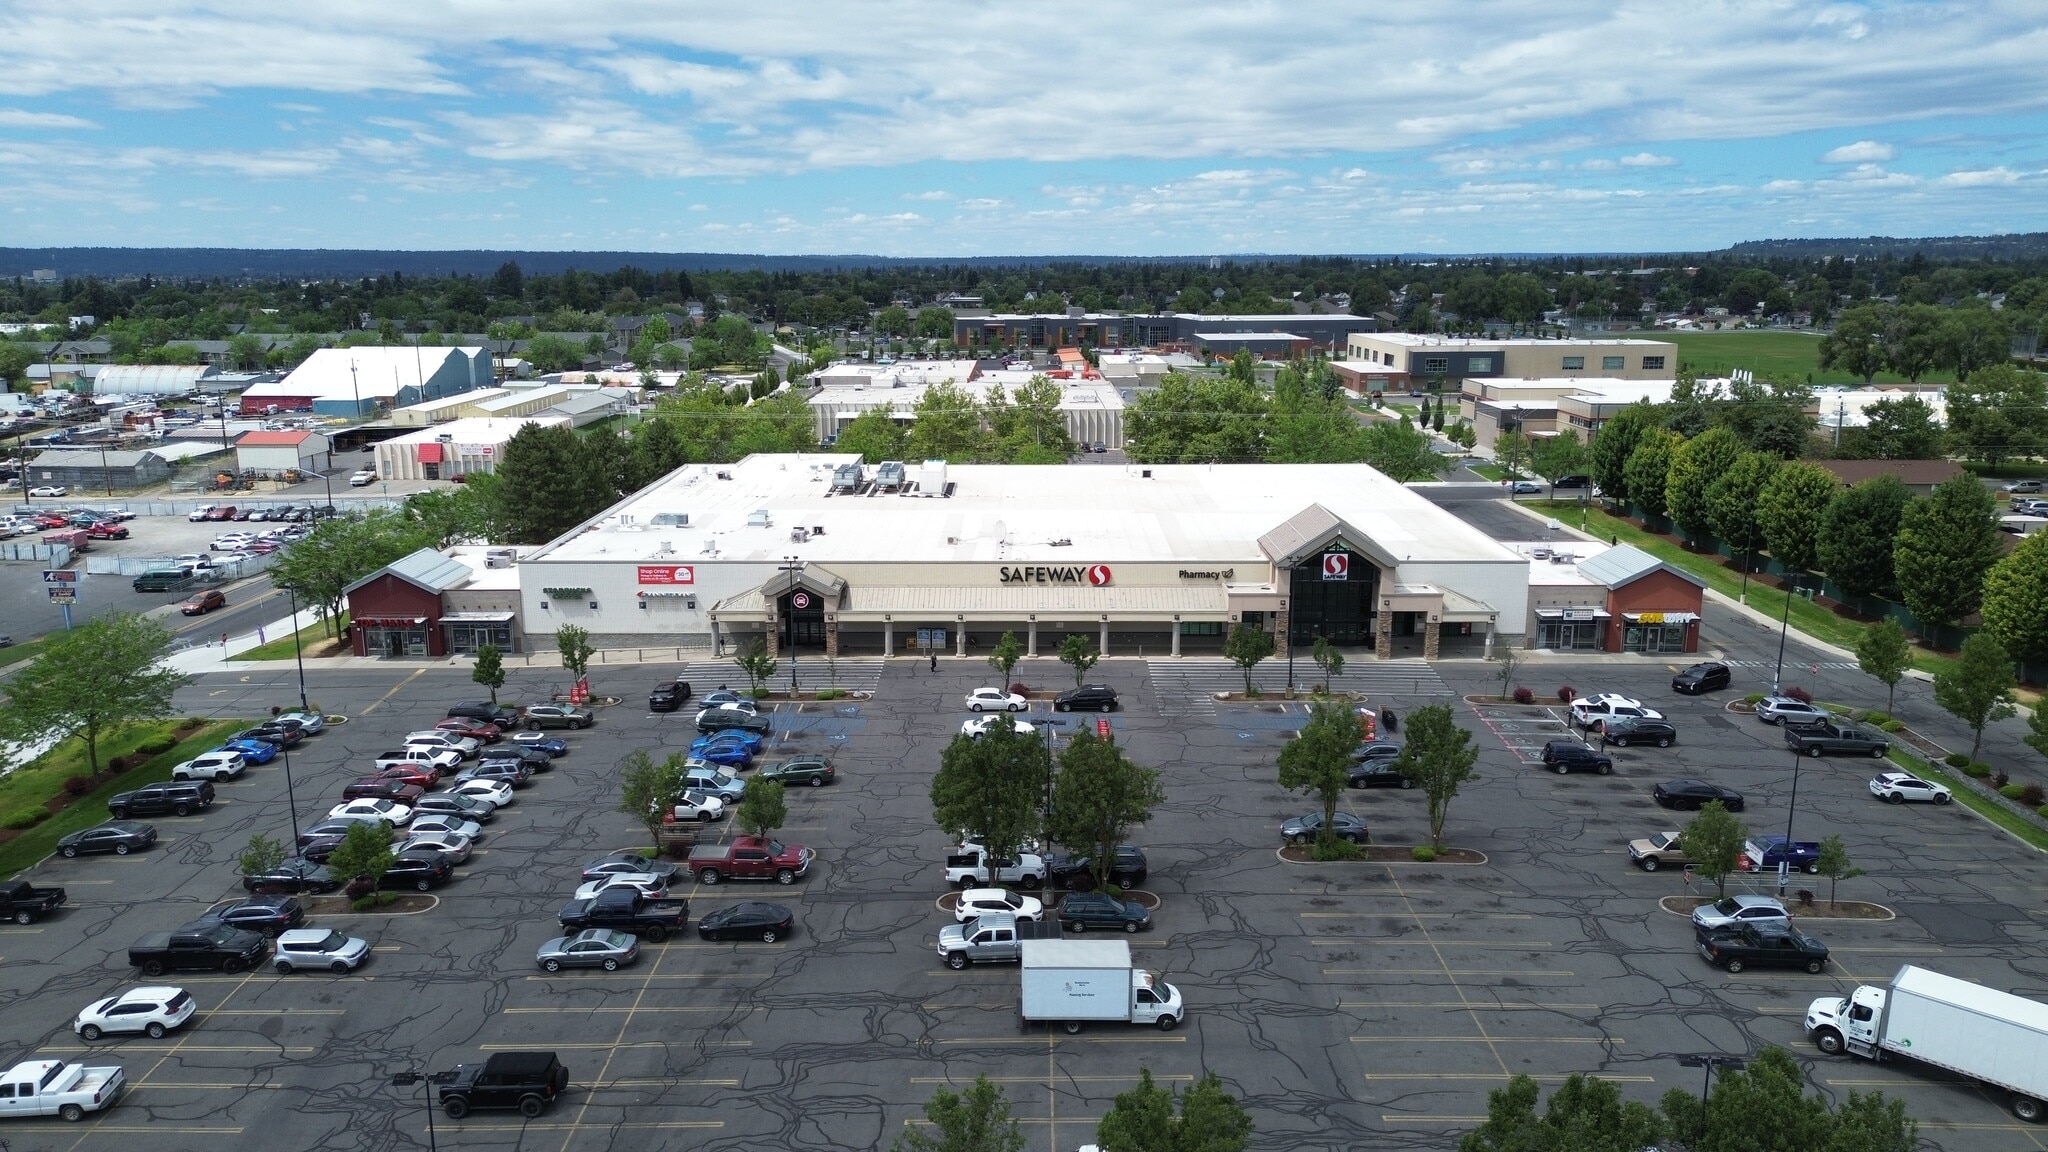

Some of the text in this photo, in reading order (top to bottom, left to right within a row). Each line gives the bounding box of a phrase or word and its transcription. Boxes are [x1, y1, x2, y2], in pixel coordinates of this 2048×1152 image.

[1000, 567, 1086, 582] SAFEWAY
[1179, 569, 1220, 580] Pharmacy
[1637, 613, 1694, 623] SUBWAY
